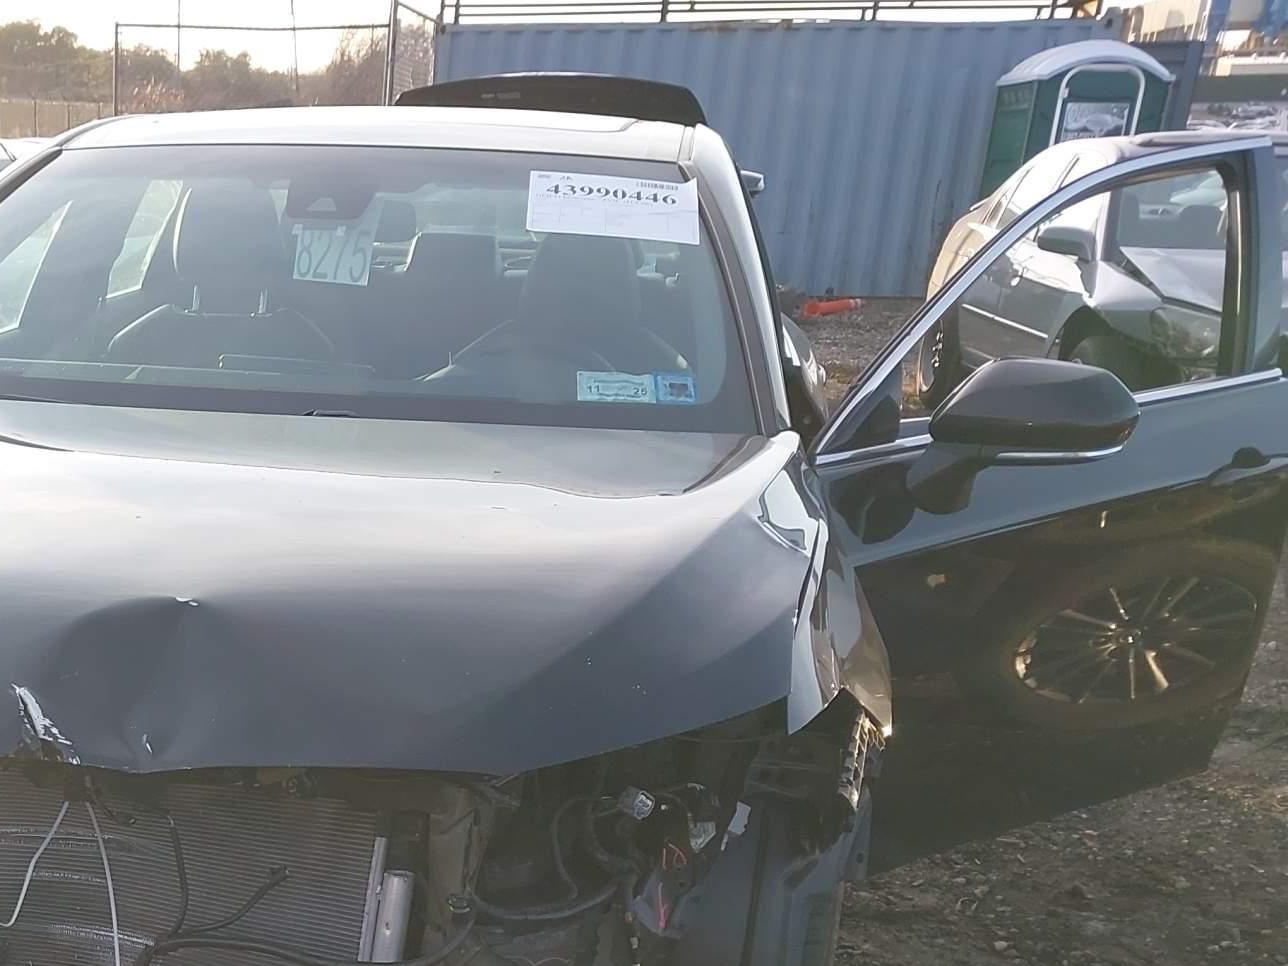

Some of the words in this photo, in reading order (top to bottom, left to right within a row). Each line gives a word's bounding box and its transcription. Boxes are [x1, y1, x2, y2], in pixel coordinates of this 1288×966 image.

[545, 183, 678, 205] 43990446
[296, 228, 368, 283] 8275
[586, 384, 601, 394] 11
